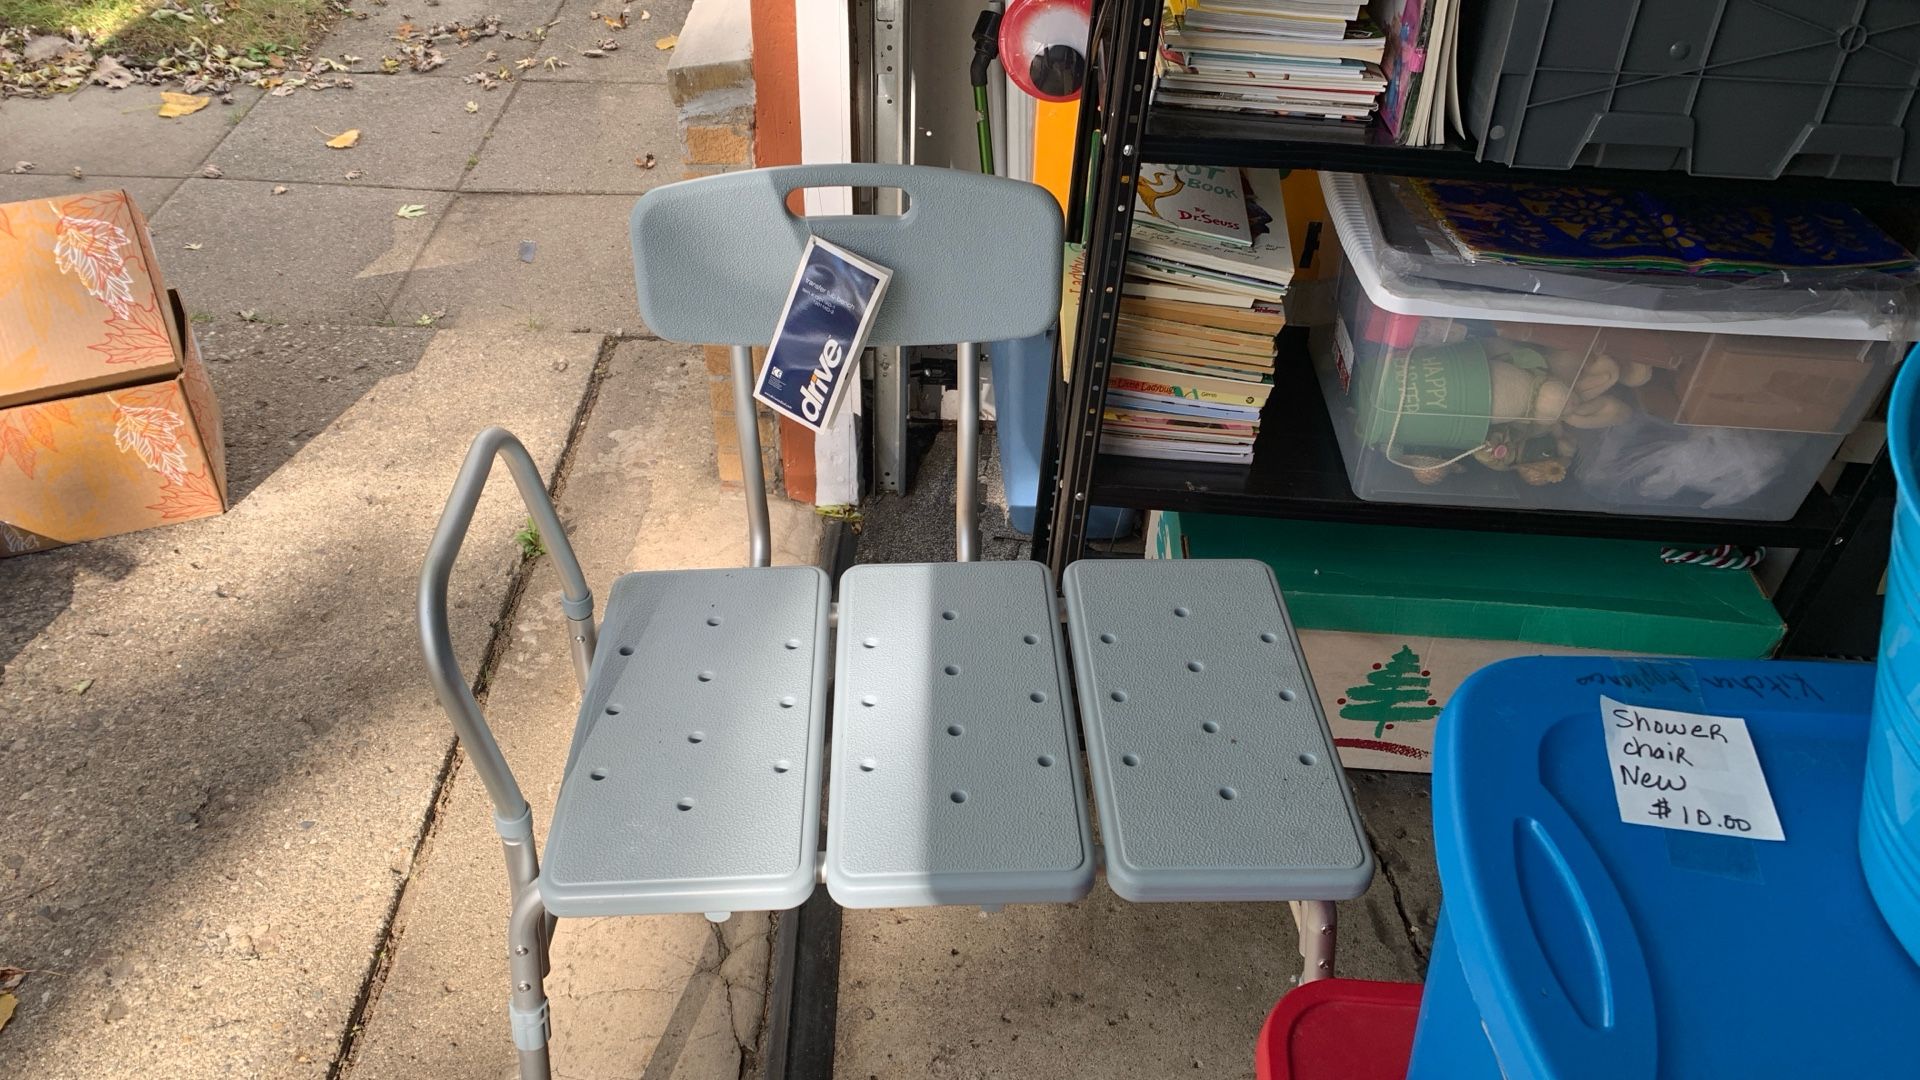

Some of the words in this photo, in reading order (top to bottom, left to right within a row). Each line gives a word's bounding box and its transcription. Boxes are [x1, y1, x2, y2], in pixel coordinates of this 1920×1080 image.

[800, 337, 843, 423] drive
[1620, 764, 1687, 792] New
[1648, 797, 1752, 832] $10.00
